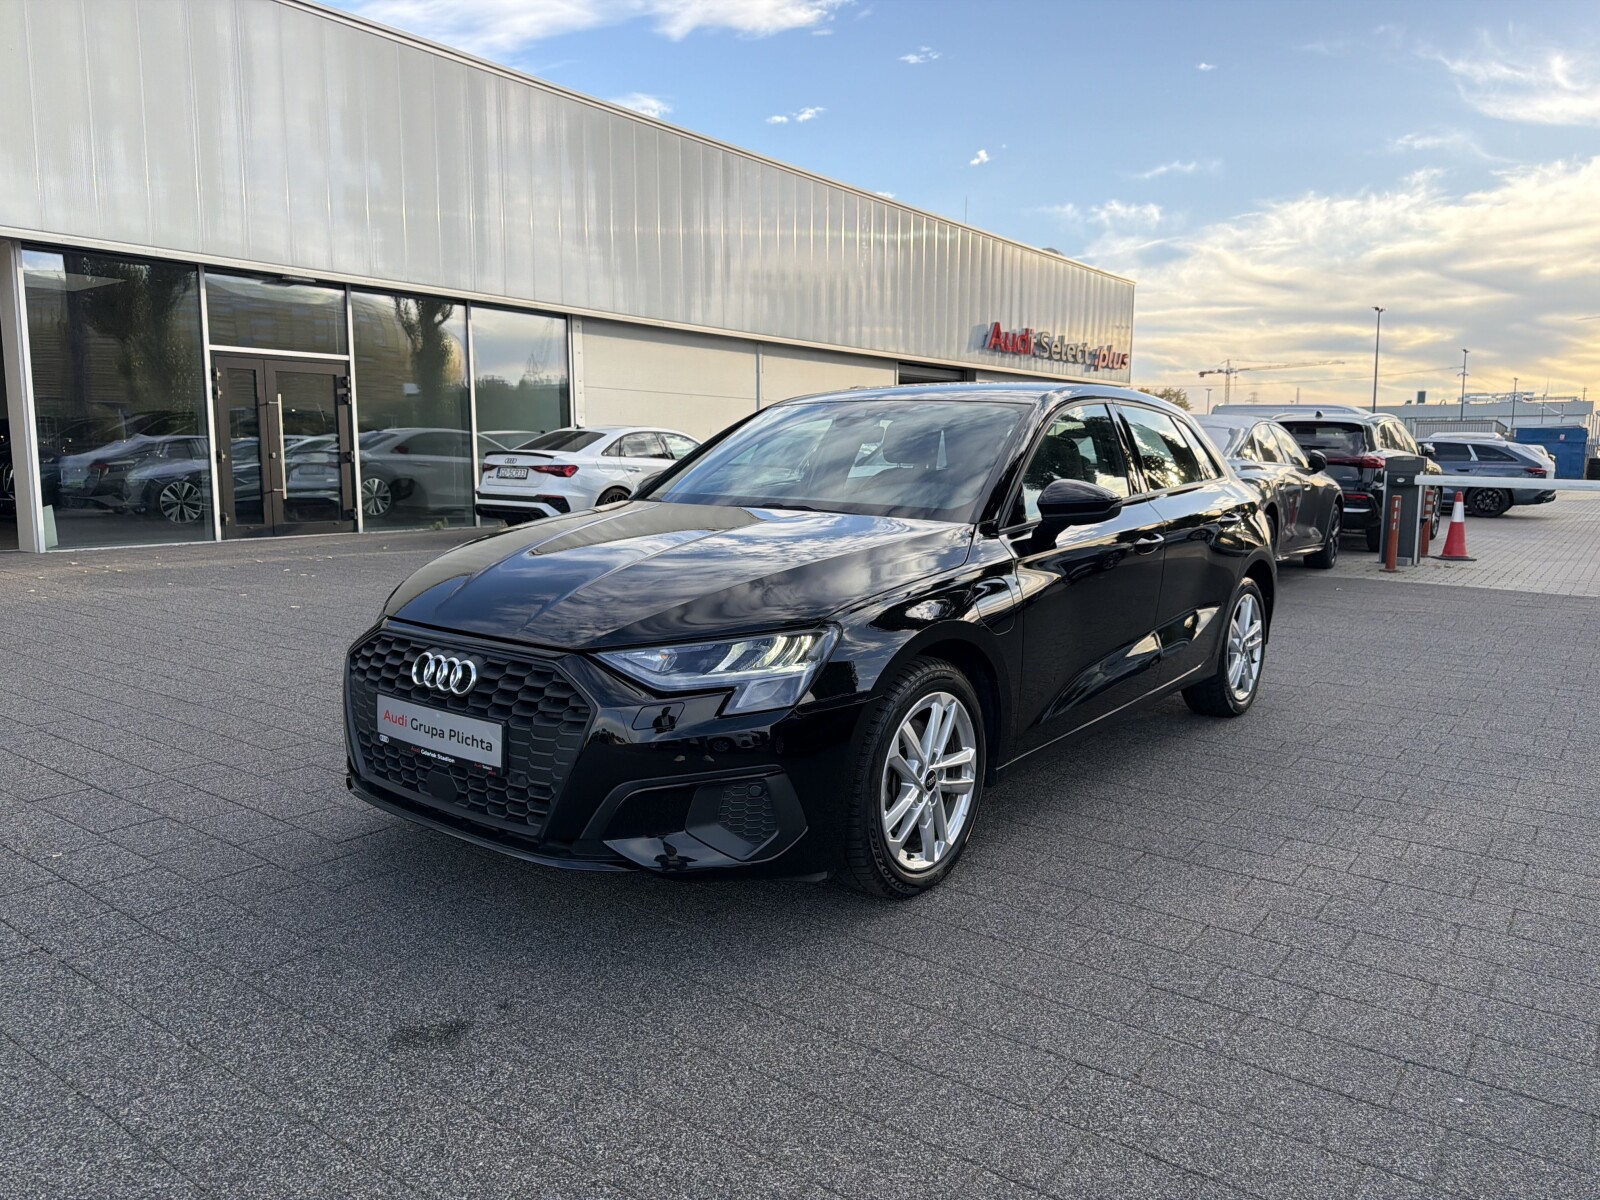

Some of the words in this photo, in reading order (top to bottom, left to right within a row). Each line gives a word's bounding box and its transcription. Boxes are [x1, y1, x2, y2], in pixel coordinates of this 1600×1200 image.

[988, 321, 1036, 356] Audi
[1040, 332, 1091, 364] Select
[383, 709, 407, 728] Audi
[410, 718, 445, 739] Grupa
[448, 729, 493, 752] Plichta
